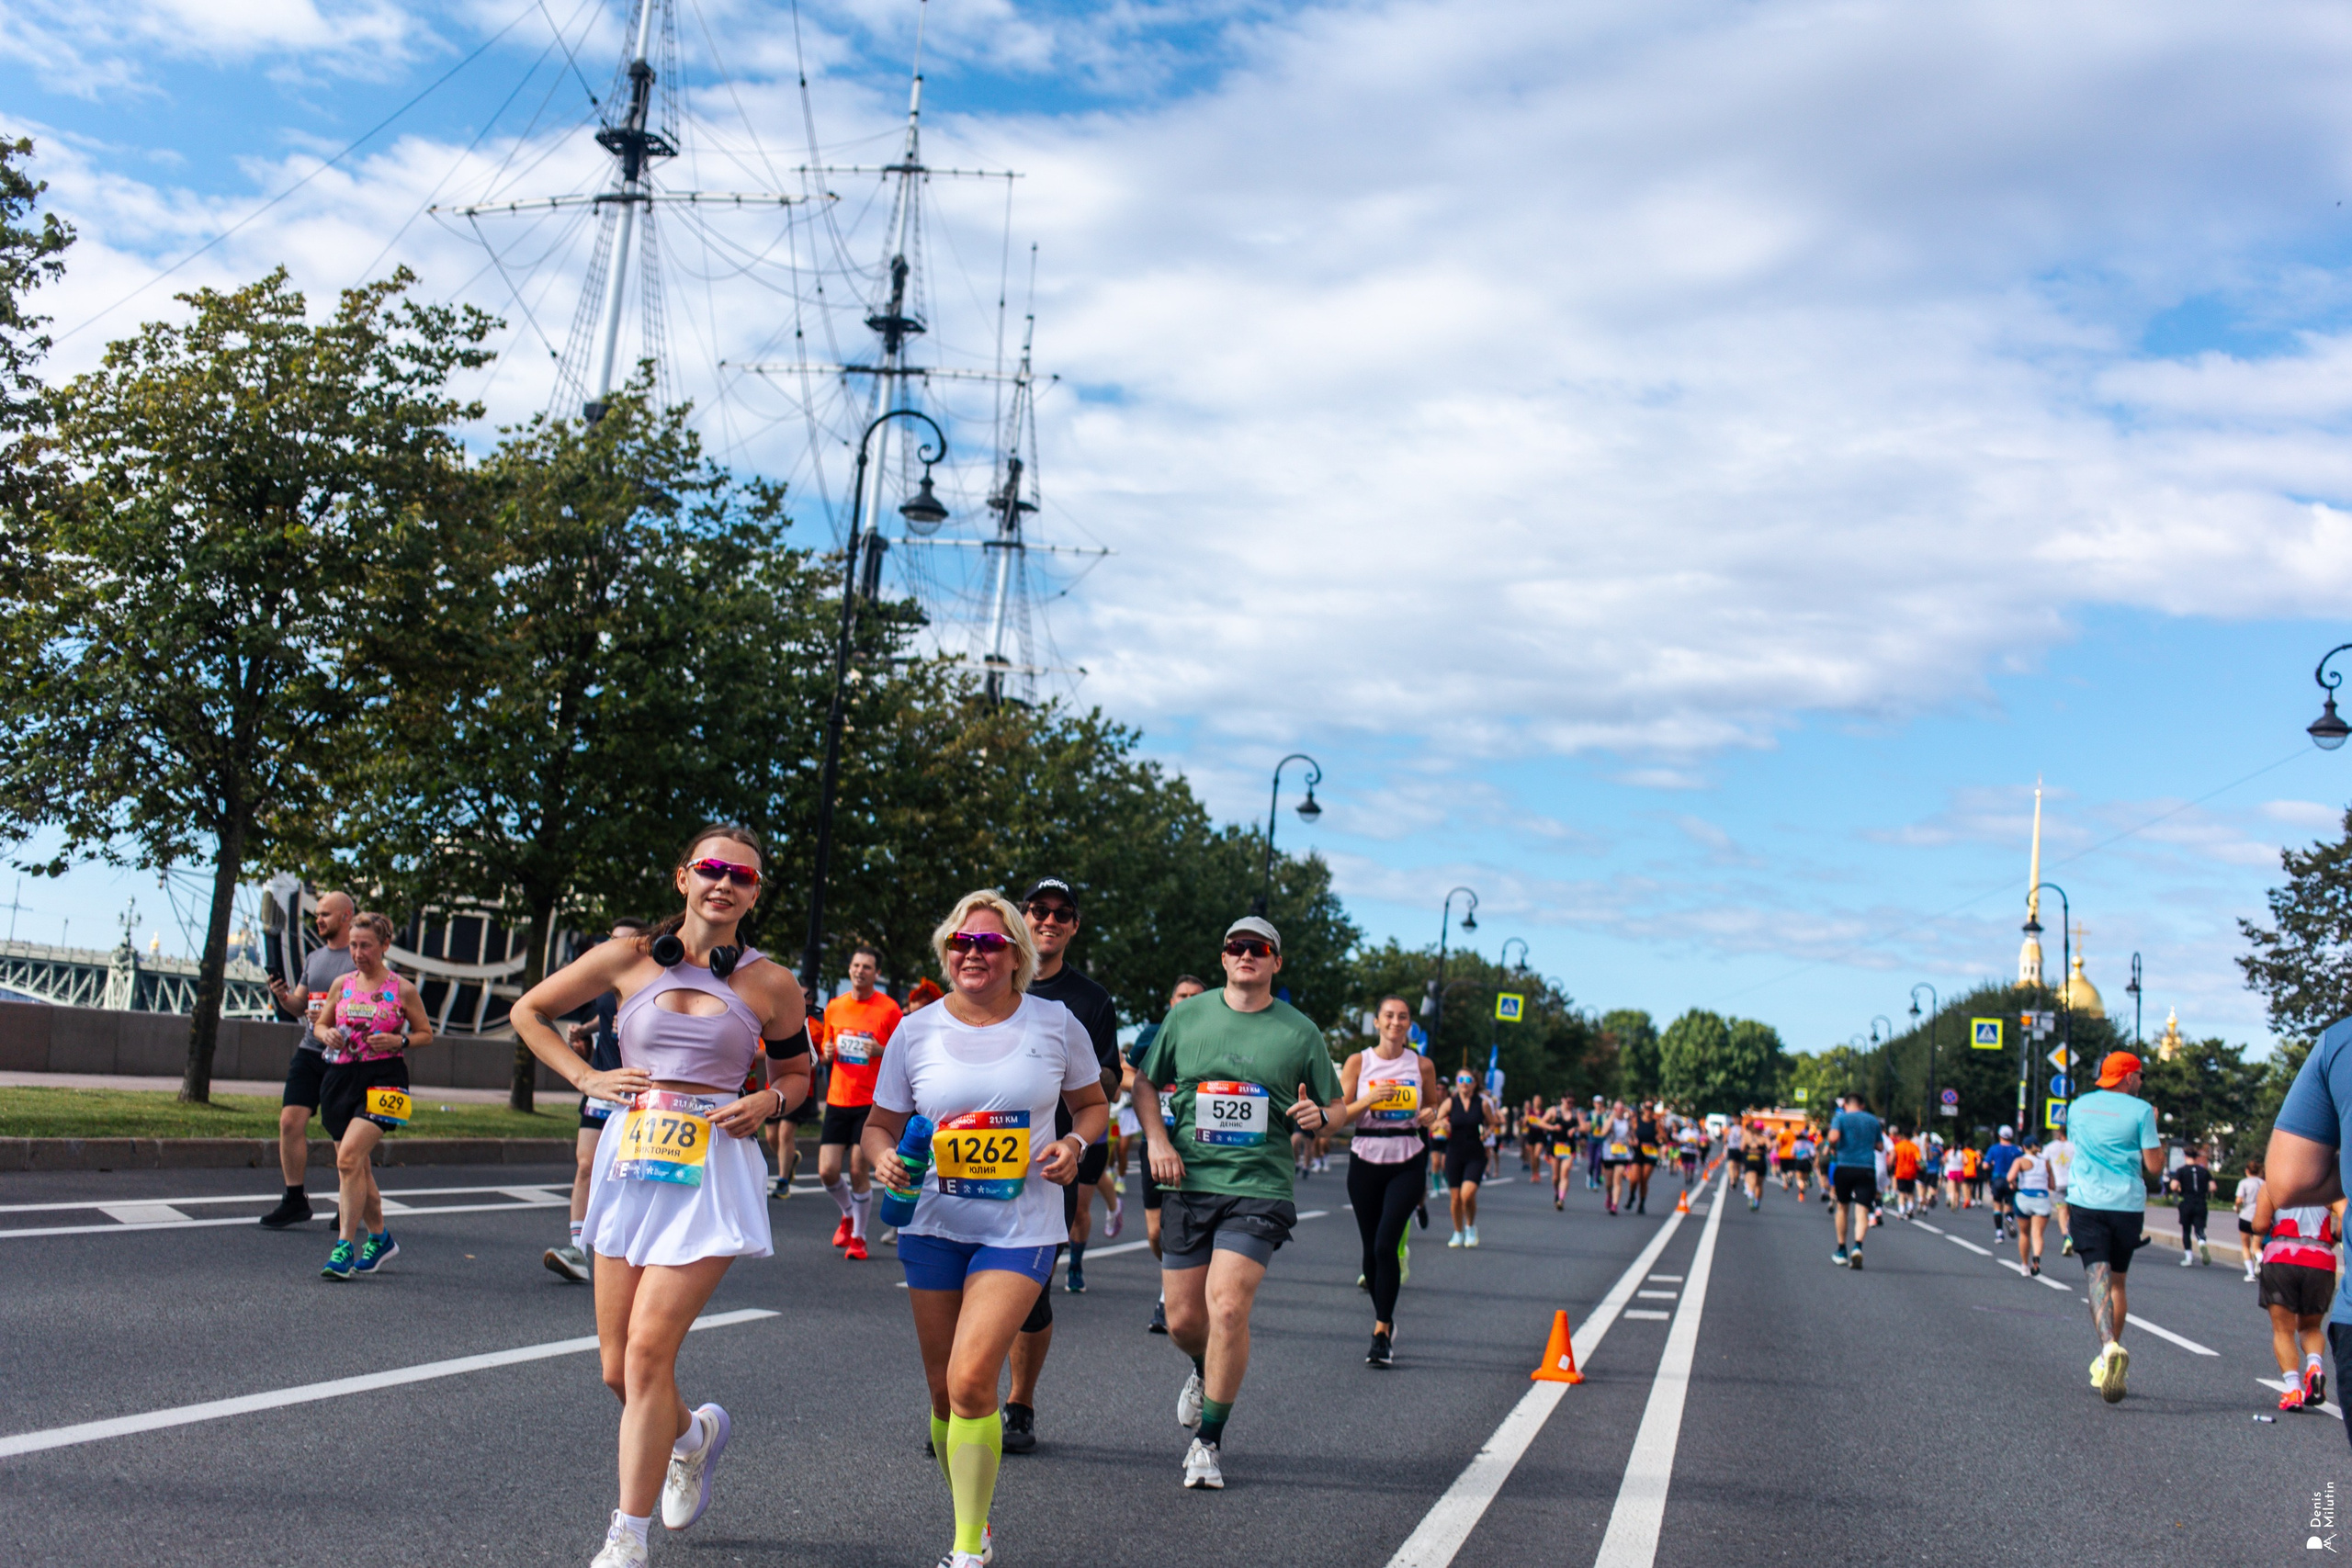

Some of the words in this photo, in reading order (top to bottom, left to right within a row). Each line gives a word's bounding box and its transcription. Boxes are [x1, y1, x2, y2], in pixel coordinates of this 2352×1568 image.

[1038, 879, 1069, 891] HOKA
[379, 1094, 404, 1111] 629
[1213, 1100, 1252, 1121] 528
[629, 1117, 697, 1148] 4178
[634, 1145, 681, 1157] ВИКТОРИЯ
[947, 1136, 1018, 1164] 1262
[969, 1166, 996, 1175] ЮЛИЯ
